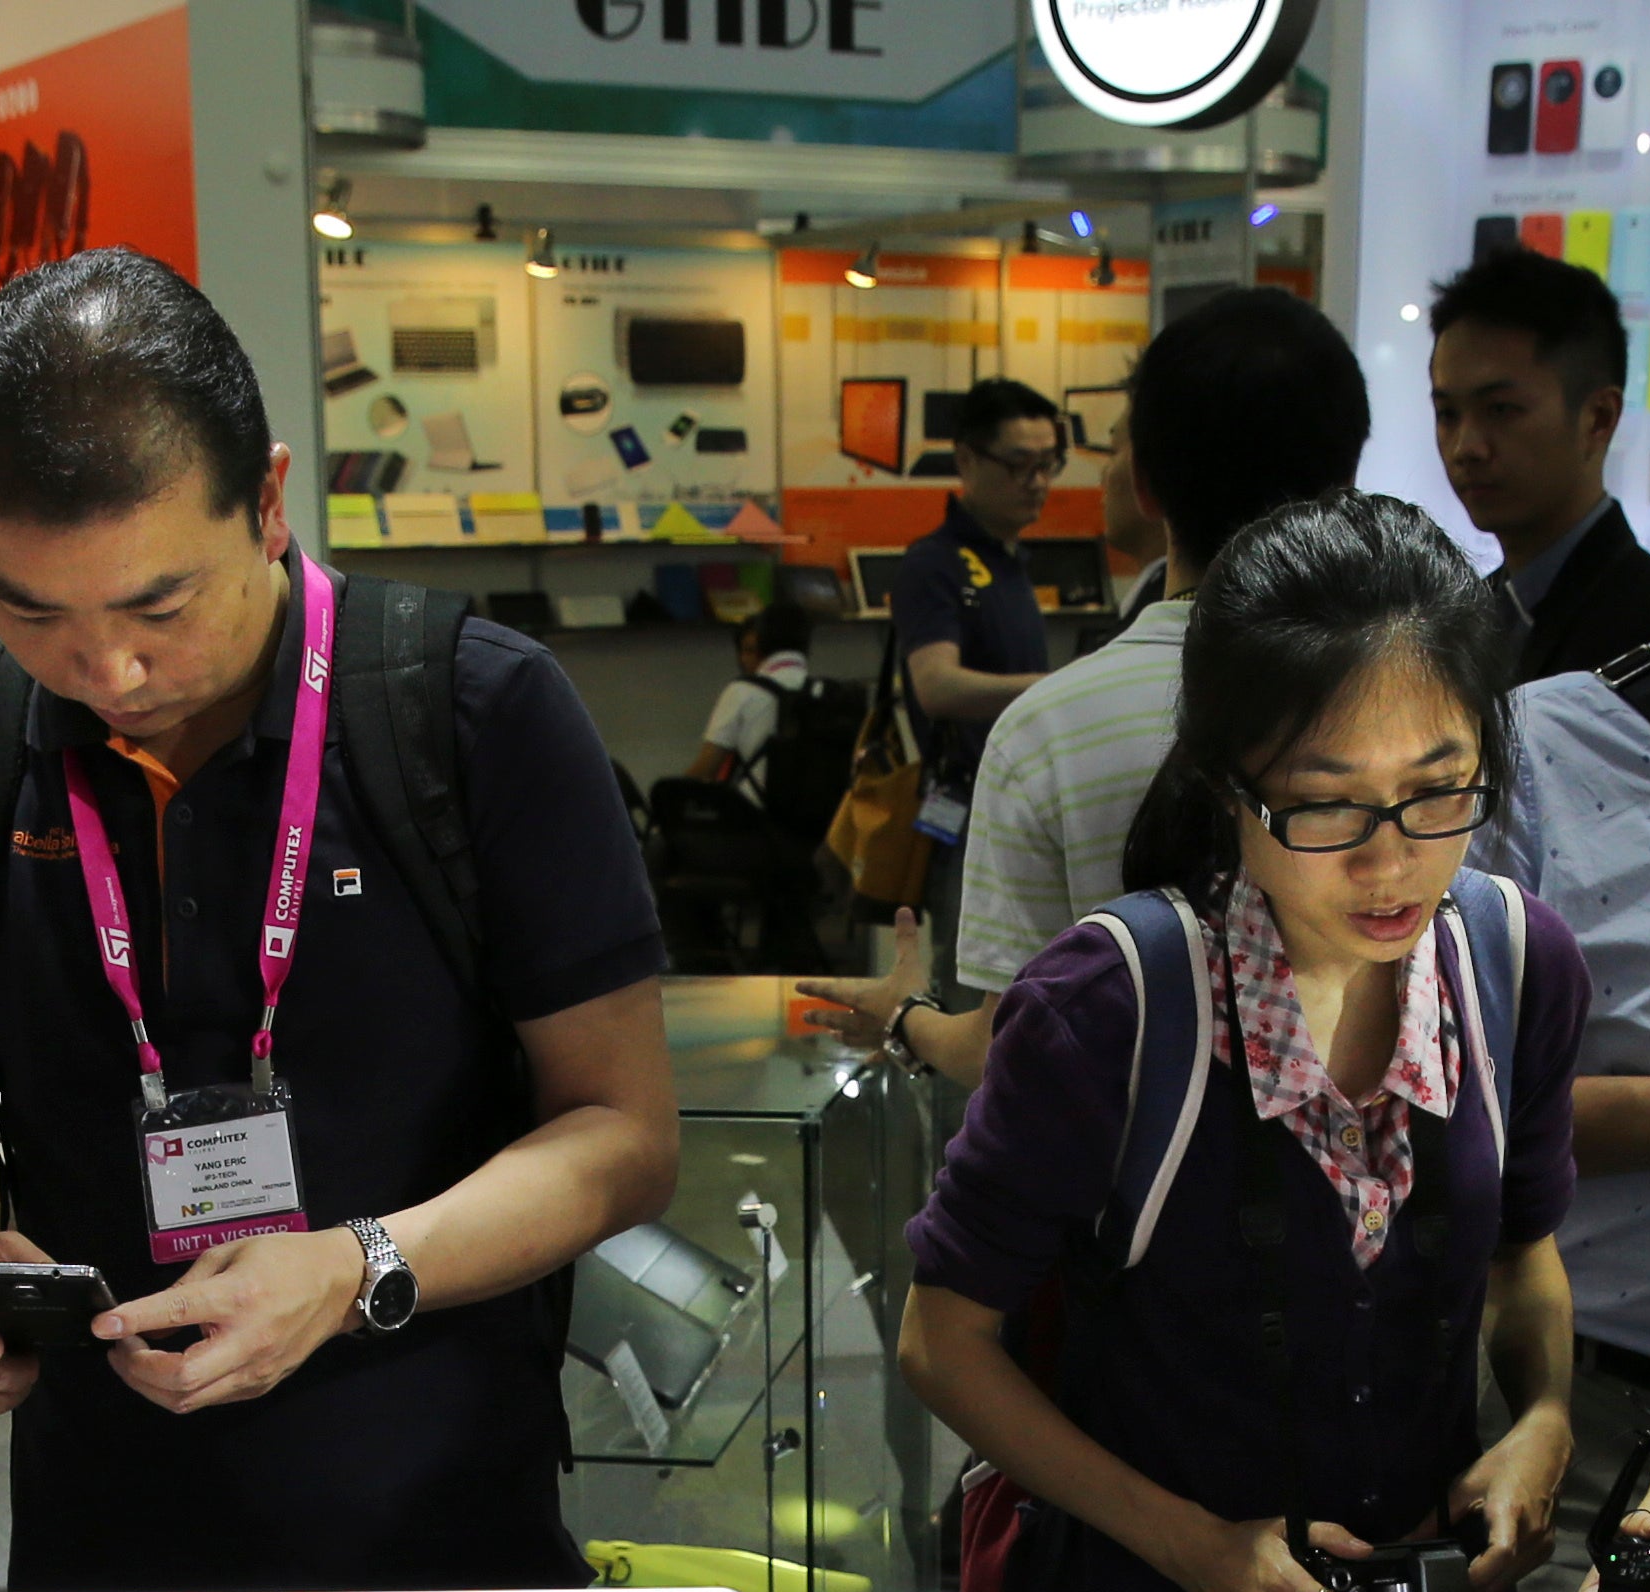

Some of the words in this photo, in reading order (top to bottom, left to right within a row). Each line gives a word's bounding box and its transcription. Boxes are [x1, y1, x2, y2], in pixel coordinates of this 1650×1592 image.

[274, 825, 303, 921] COMPUTEX
[187, 1132, 248, 1149] COMPUTEX
[194, 1159, 222, 1172] YANG
[224, 1156, 247, 1168] ERIC
[192, 1182, 230, 1194] MAINLAND
[231, 1178, 254, 1188] CHINA
[173, 1233, 218, 1252] INT'L
